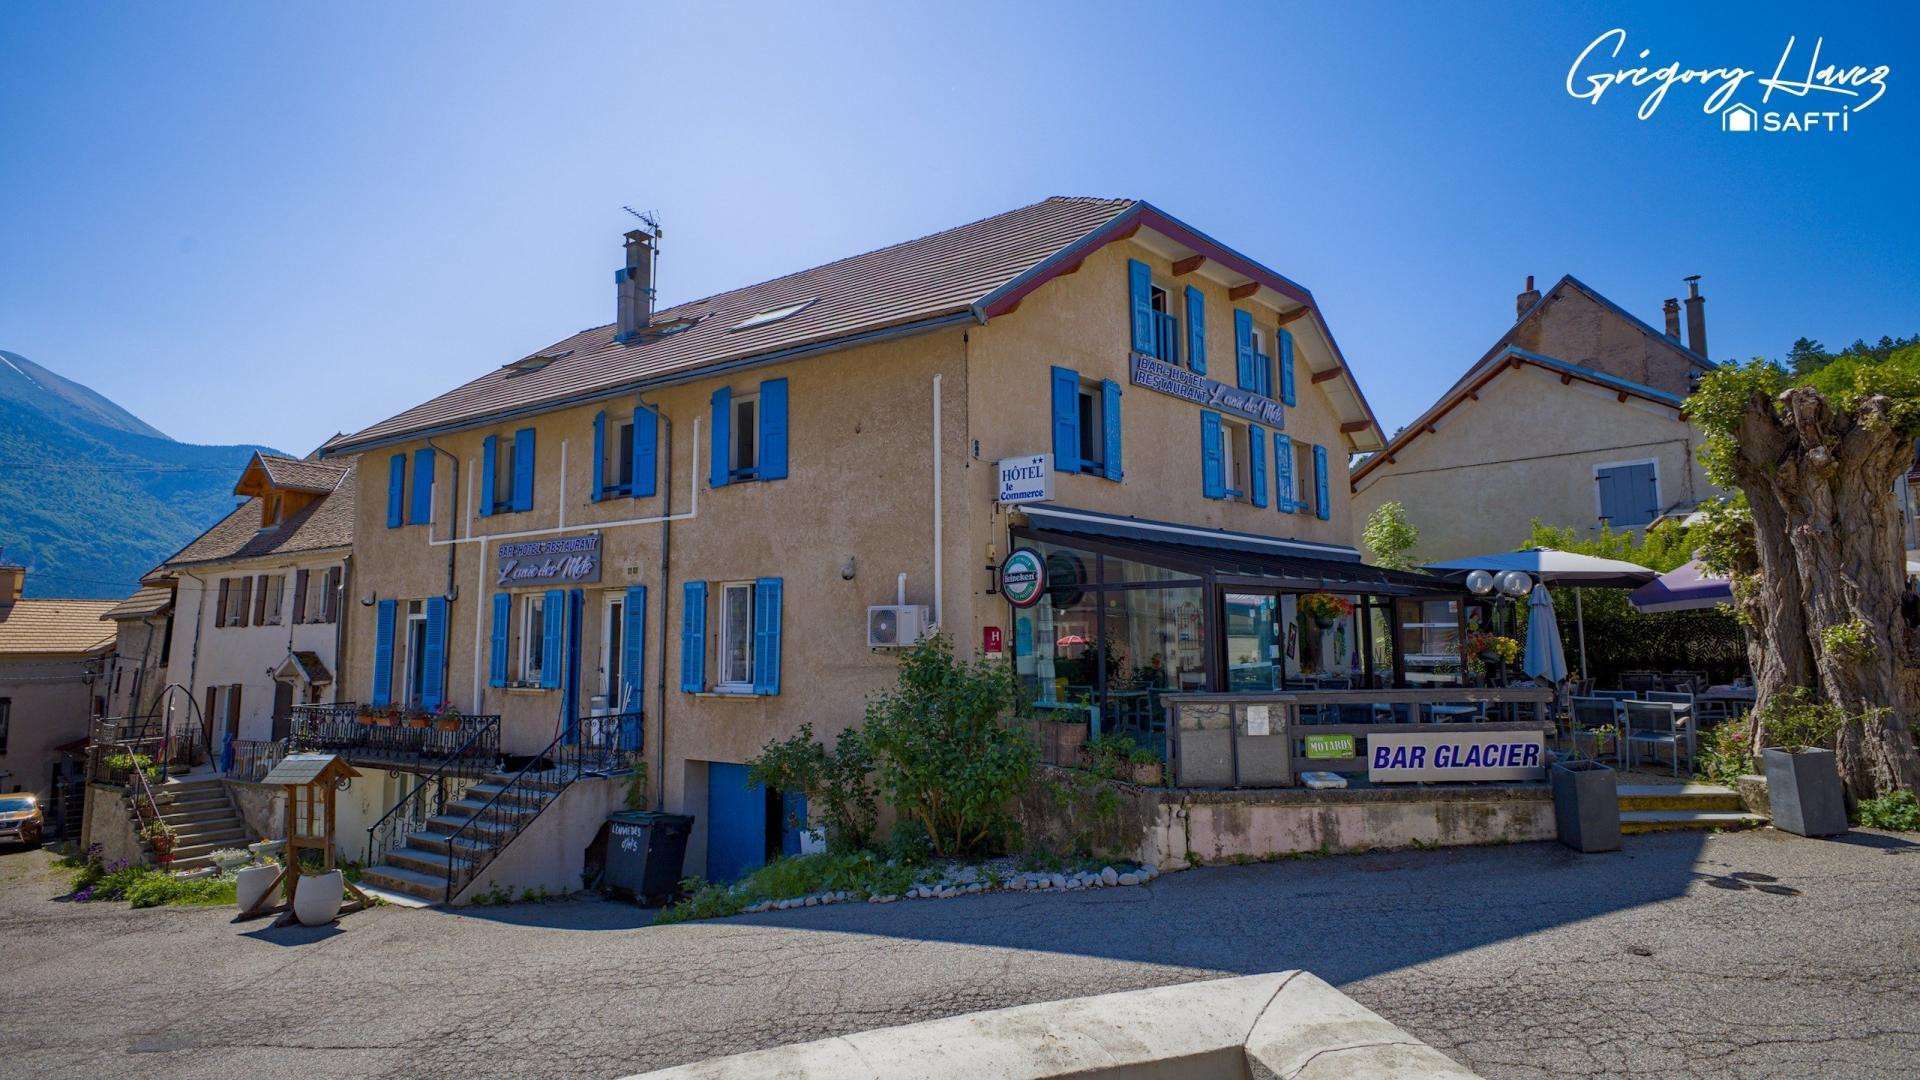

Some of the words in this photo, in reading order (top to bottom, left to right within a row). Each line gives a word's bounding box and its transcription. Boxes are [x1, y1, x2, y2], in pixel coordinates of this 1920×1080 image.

[1139, 357, 1164, 376] BAR
[1136, 370, 1206, 403] RESTAURANT
[1002, 465, 1044, 482] HÔTEL
[1000, 489, 1044, 501] Commerce
[1005, 482, 1014, 491] le
[546, 537, 598, 554] RESTAURANT
[991, 631, 1000, 642] H
[1310, 739, 1352, 752] MOTARDS
[1373, 745, 1426, 769] BAR
[1433, 743, 1541, 769] GLACIER
